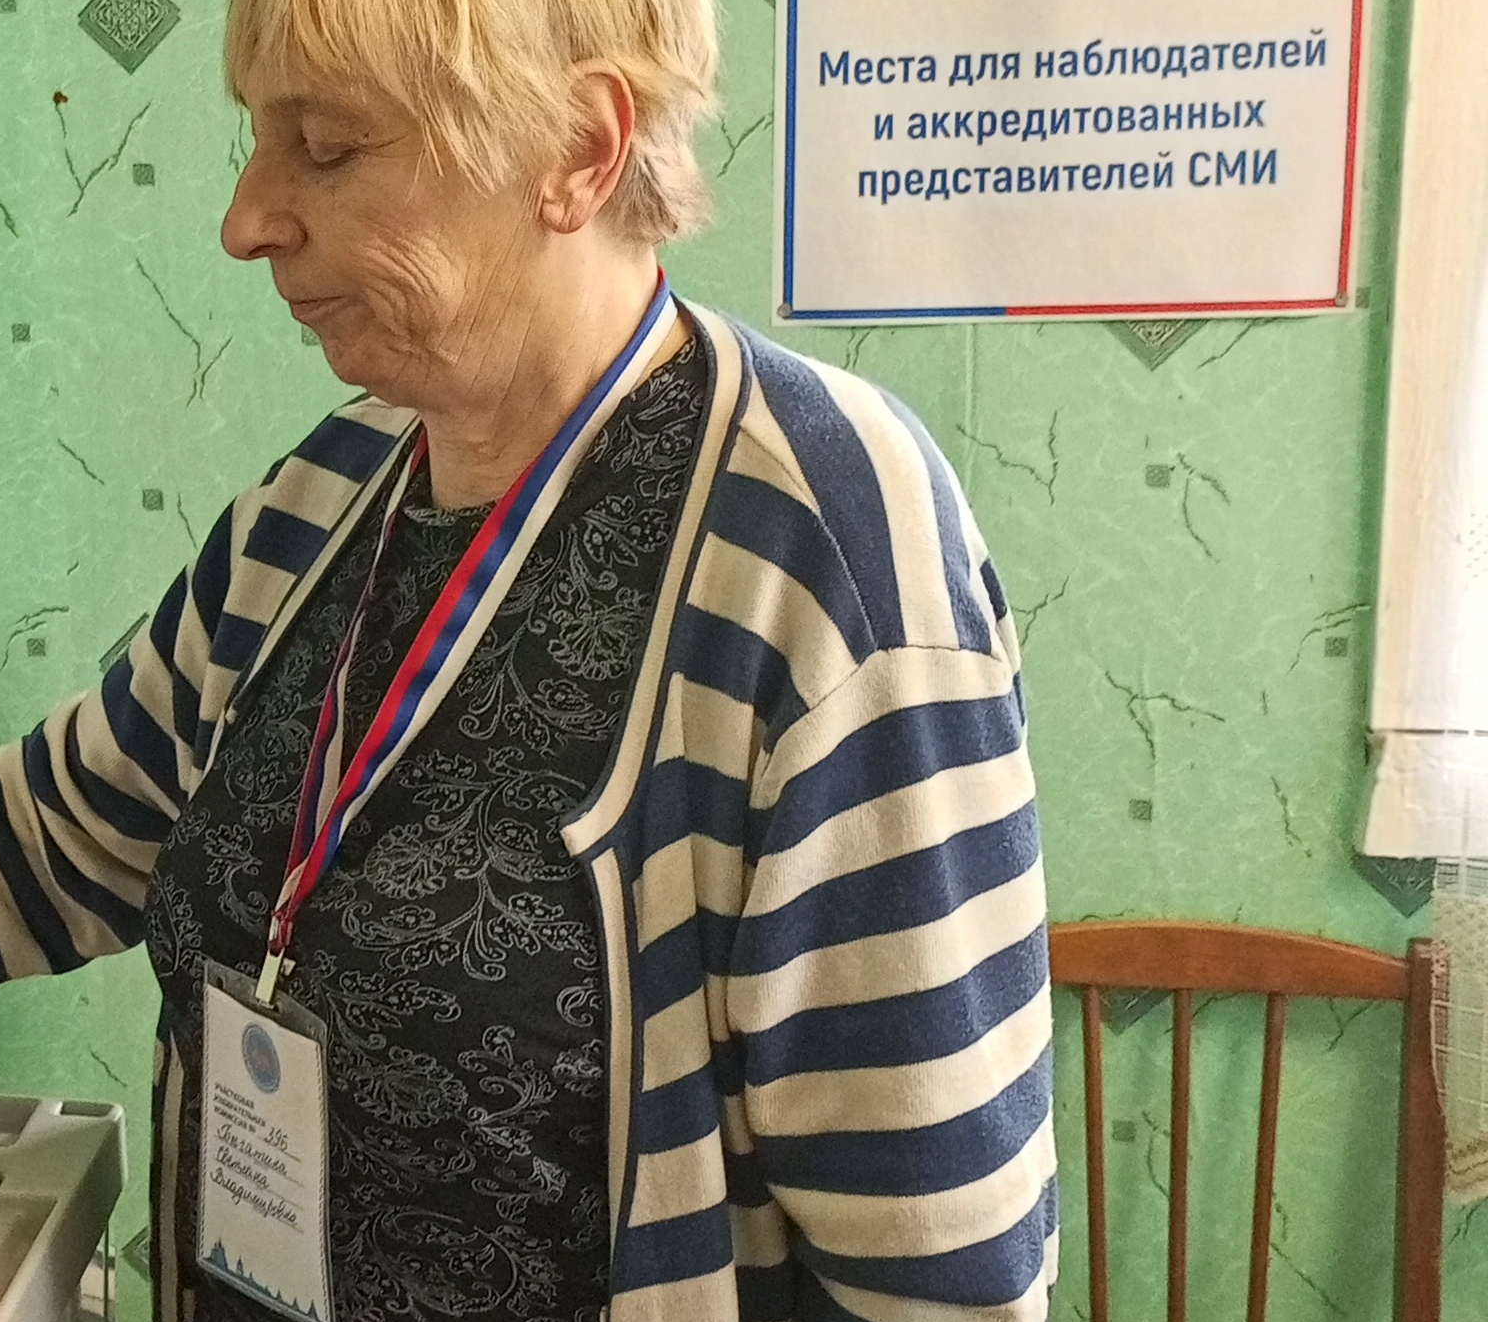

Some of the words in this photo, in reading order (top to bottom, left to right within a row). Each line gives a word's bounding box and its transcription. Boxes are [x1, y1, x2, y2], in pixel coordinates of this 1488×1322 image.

[820, 51, 937, 86] Места
[949, 47, 1020, 86] для
[1034, 30, 1328, 79] наблюдателей
[874, 113, 893, 139] и
[907, 98, 1265, 145] аккредитованных
[858, 153, 1174, 203] представителей
[1188, 149, 1278, 188] СМИ
